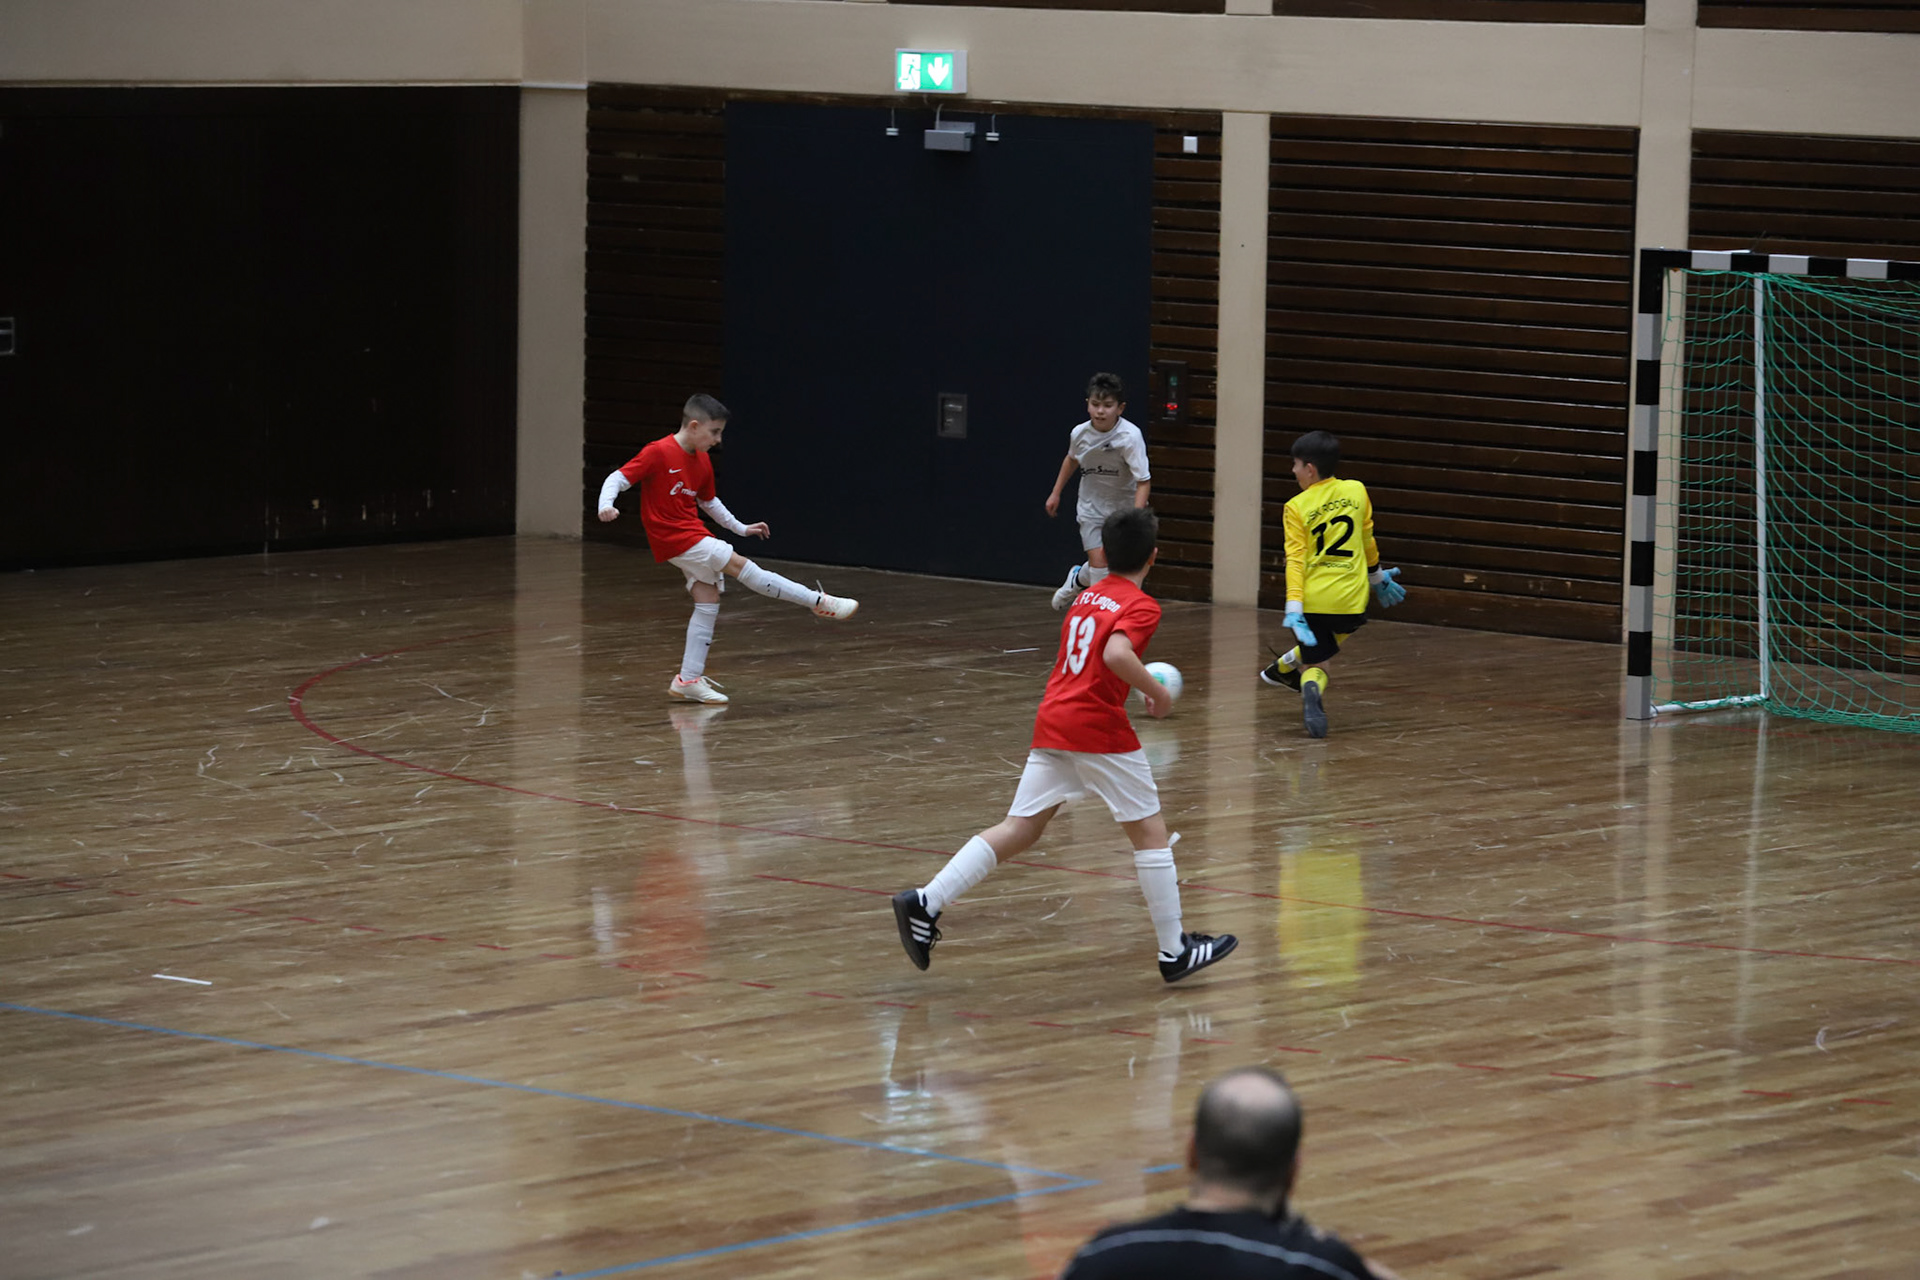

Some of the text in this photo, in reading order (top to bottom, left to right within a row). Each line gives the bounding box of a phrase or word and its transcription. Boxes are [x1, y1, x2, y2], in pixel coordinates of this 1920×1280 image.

[1311, 515, 1354, 557] 12
[1080, 592, 1094, 605] FC
[1062, 616, 1096, 675] 13
